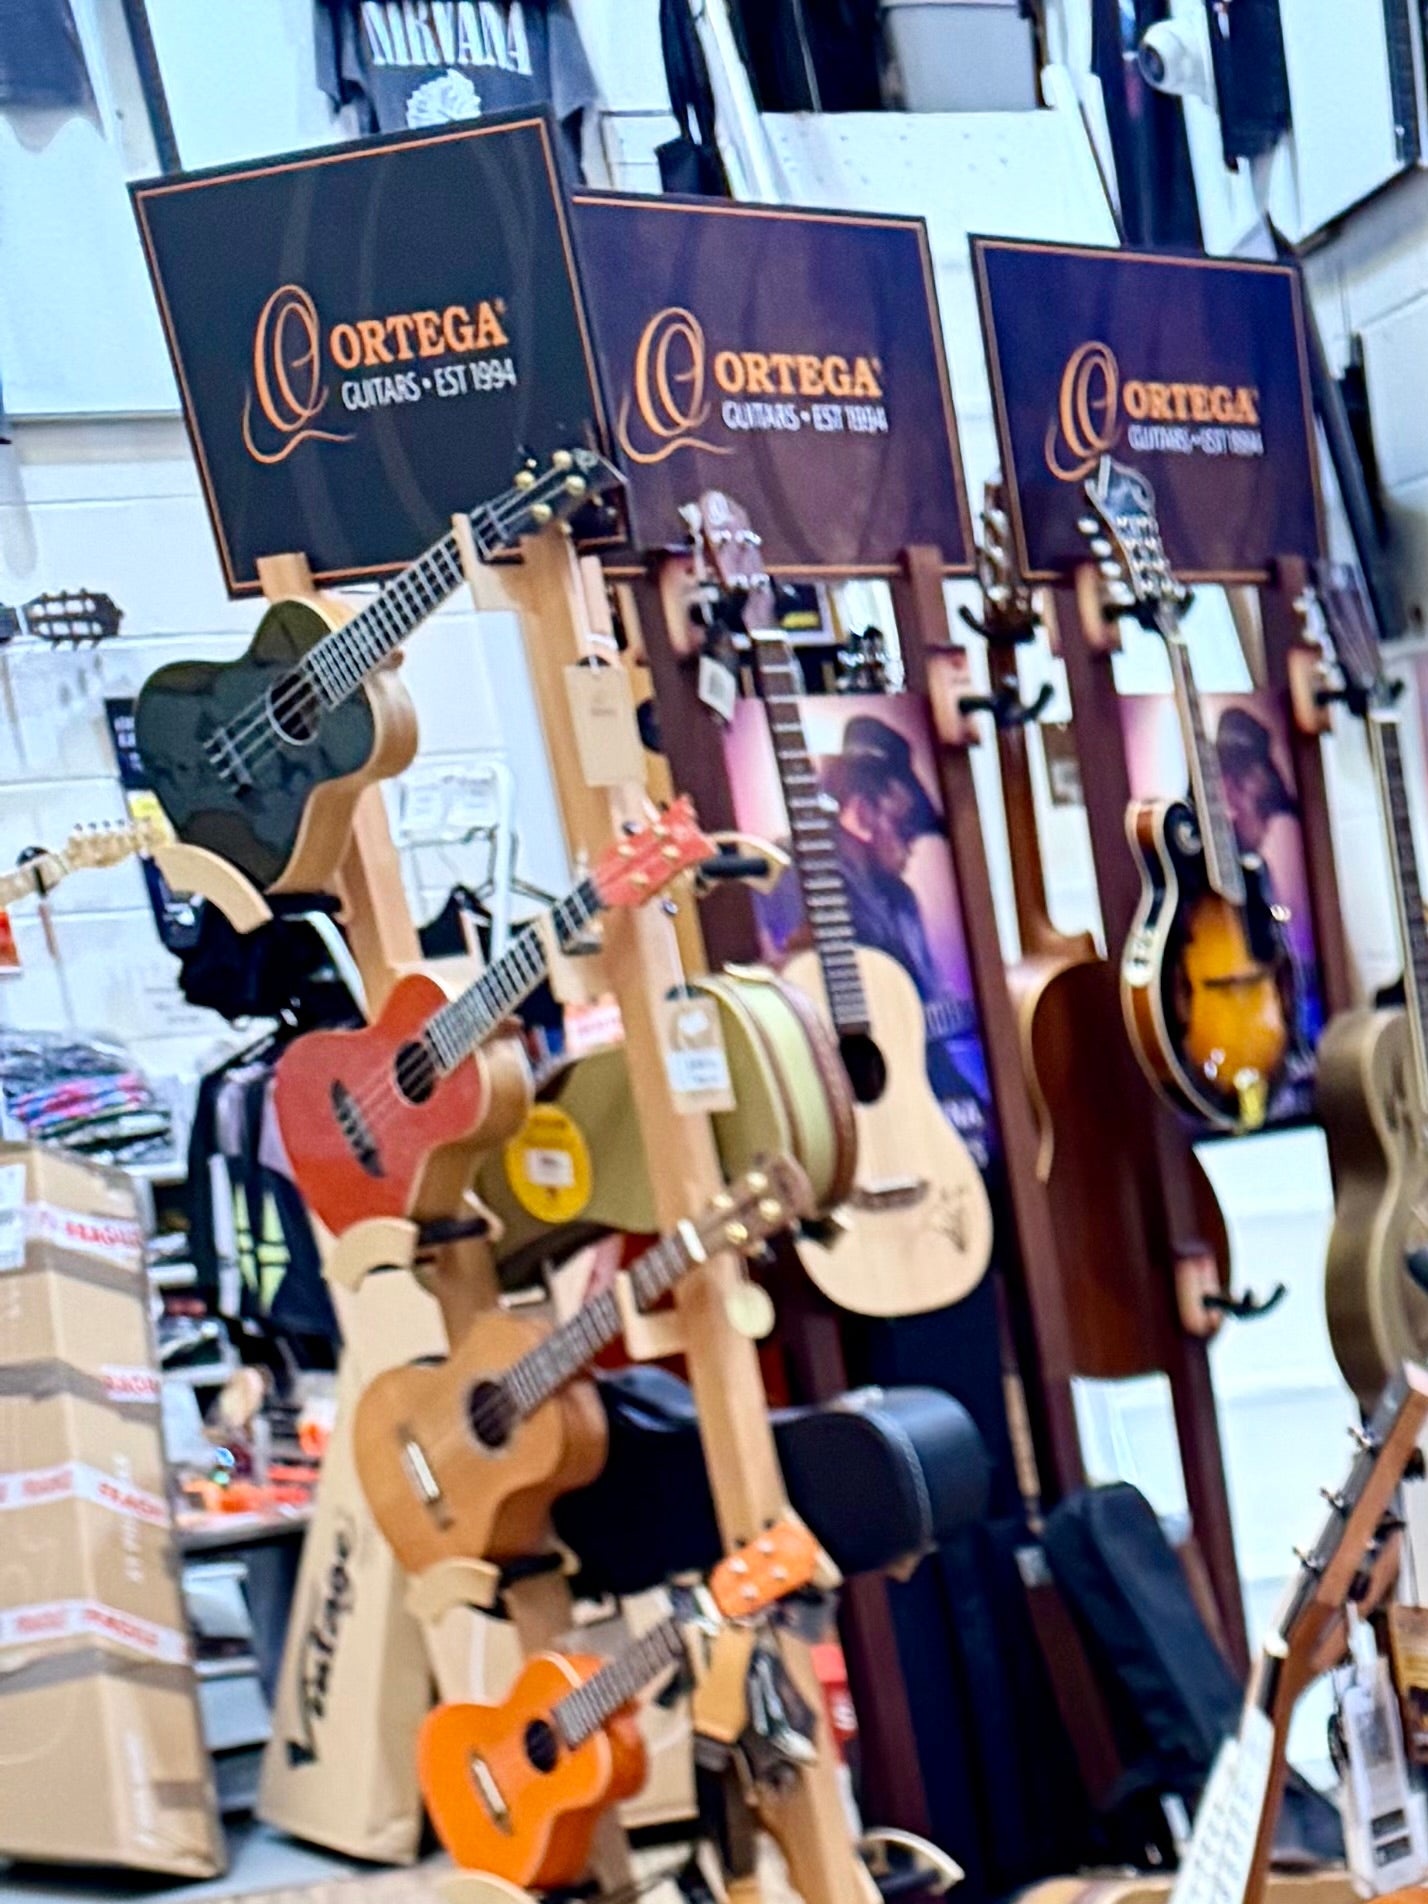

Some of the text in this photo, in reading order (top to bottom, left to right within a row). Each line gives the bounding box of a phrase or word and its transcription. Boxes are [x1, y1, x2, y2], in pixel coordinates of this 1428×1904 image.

[360, 0, 532, 76] NIRVANA
[330, 301, 508, 369] ORTEGA
[341, 358, 517, 411] GUITARS EST 1994
[714, 351, 882, 397] ORTEGA
[1123, 380, 1259, 425] ORTEGA
